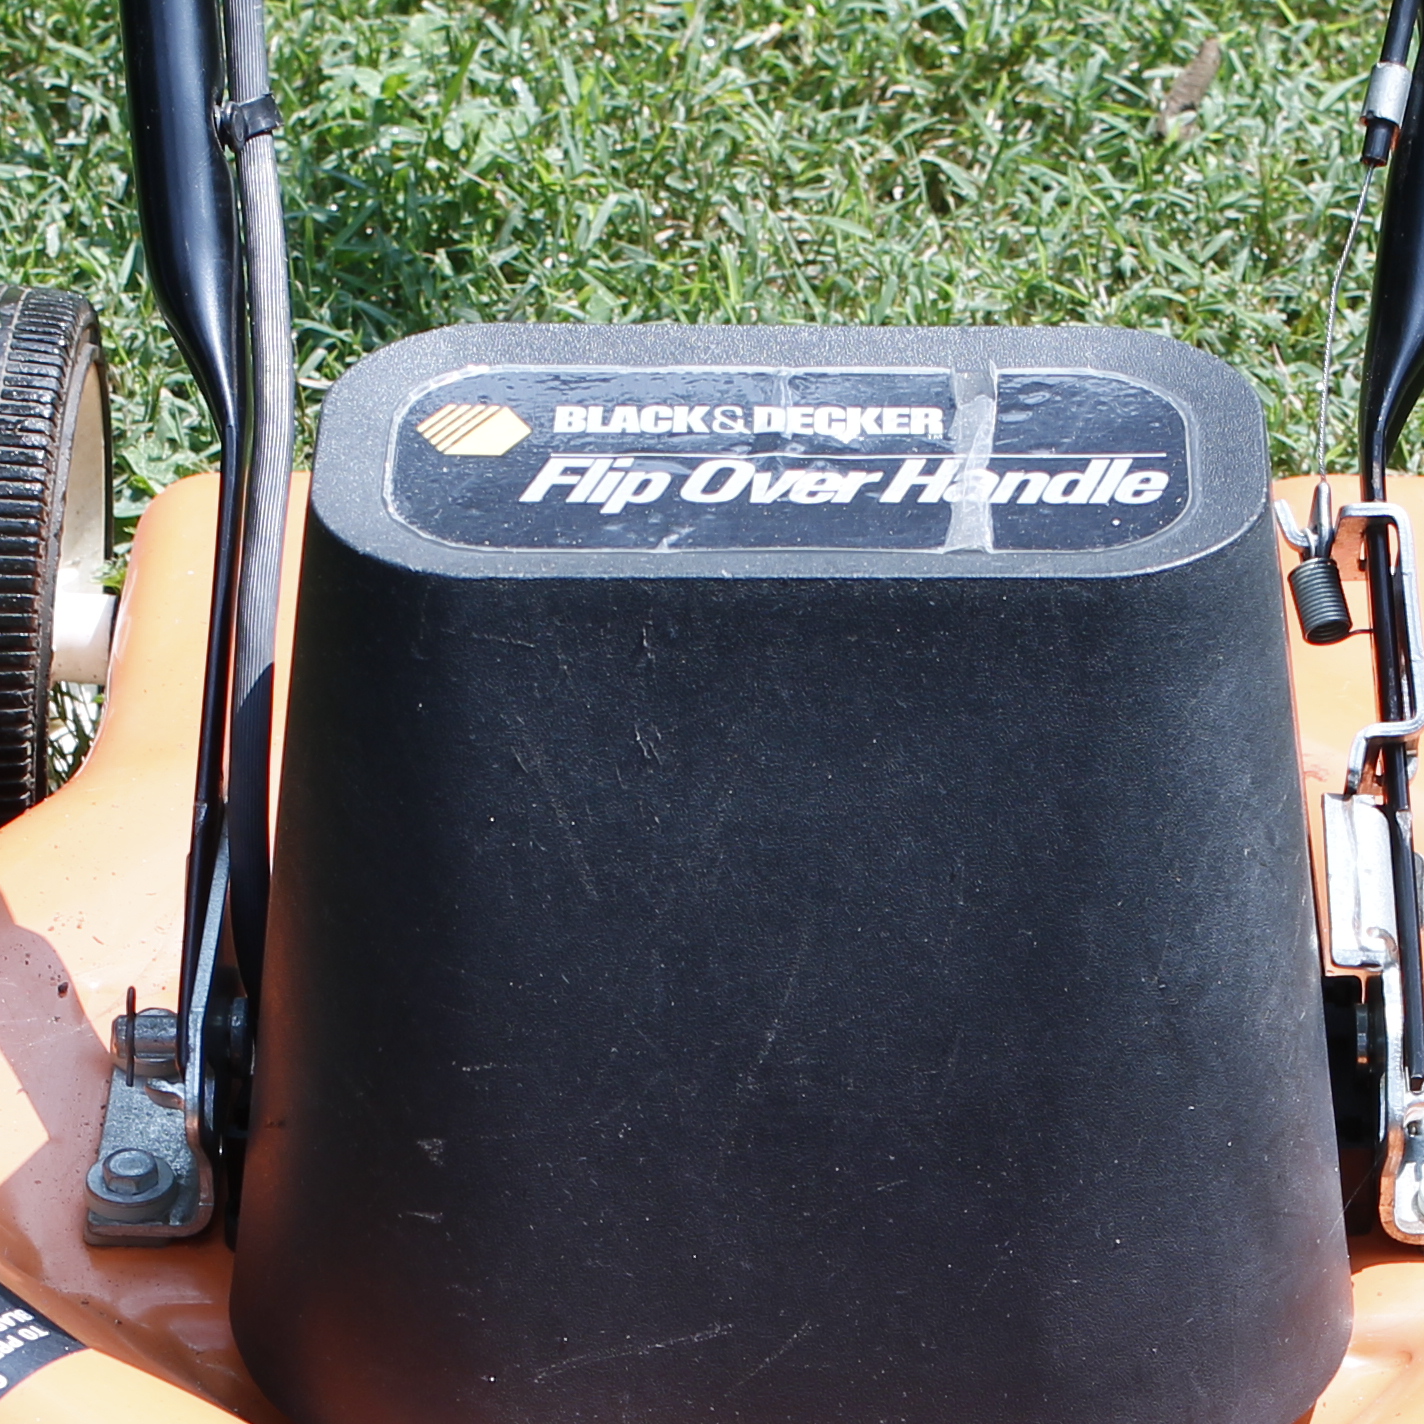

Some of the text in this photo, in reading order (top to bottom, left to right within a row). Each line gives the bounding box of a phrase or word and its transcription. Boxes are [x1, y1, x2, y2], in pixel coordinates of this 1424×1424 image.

[519, 456, 1170, 514] Flip Over Handle
[18, 1325, 50, 1341] TO
